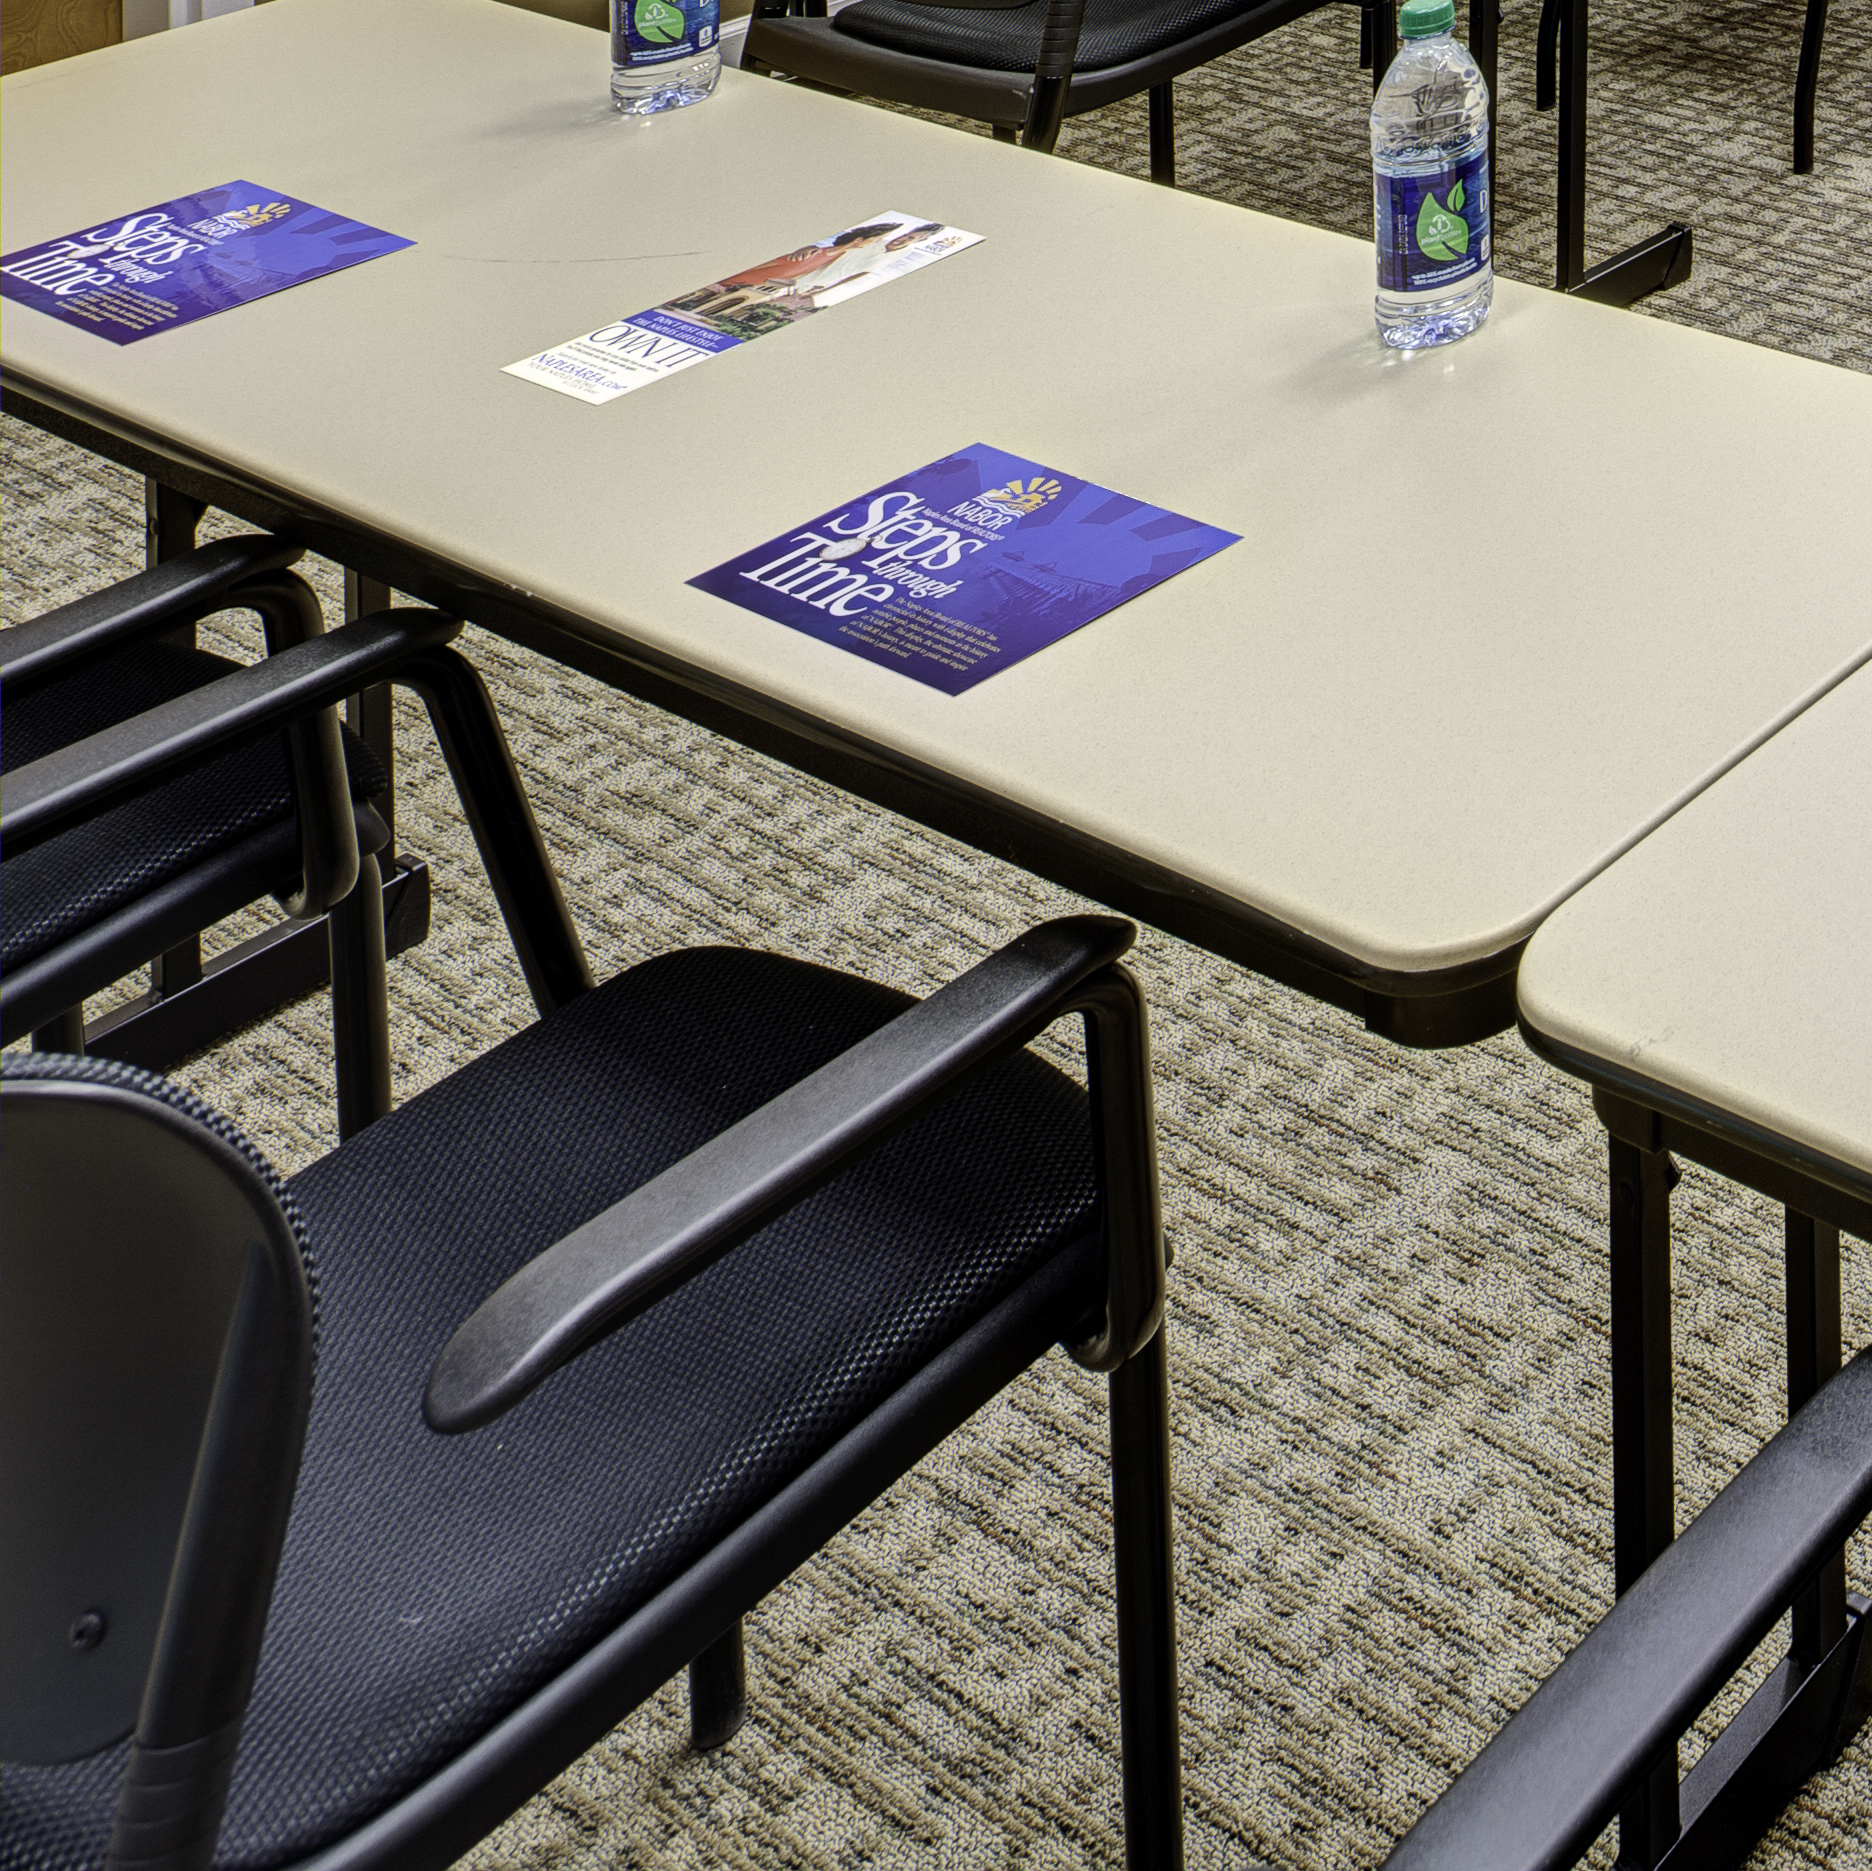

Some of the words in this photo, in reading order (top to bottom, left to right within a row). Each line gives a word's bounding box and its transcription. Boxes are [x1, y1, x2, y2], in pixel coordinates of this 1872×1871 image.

[80, 212, 208, 265] Steps
[589, 325, 679, 359] OWN
[655, 347, 710, 368] IT
[822, 491, 988, 570] Steps
[946, 501, 1013, 530] NABOR
[738, 532, 895, 616] Time
[871, 560, 965, 599] through
